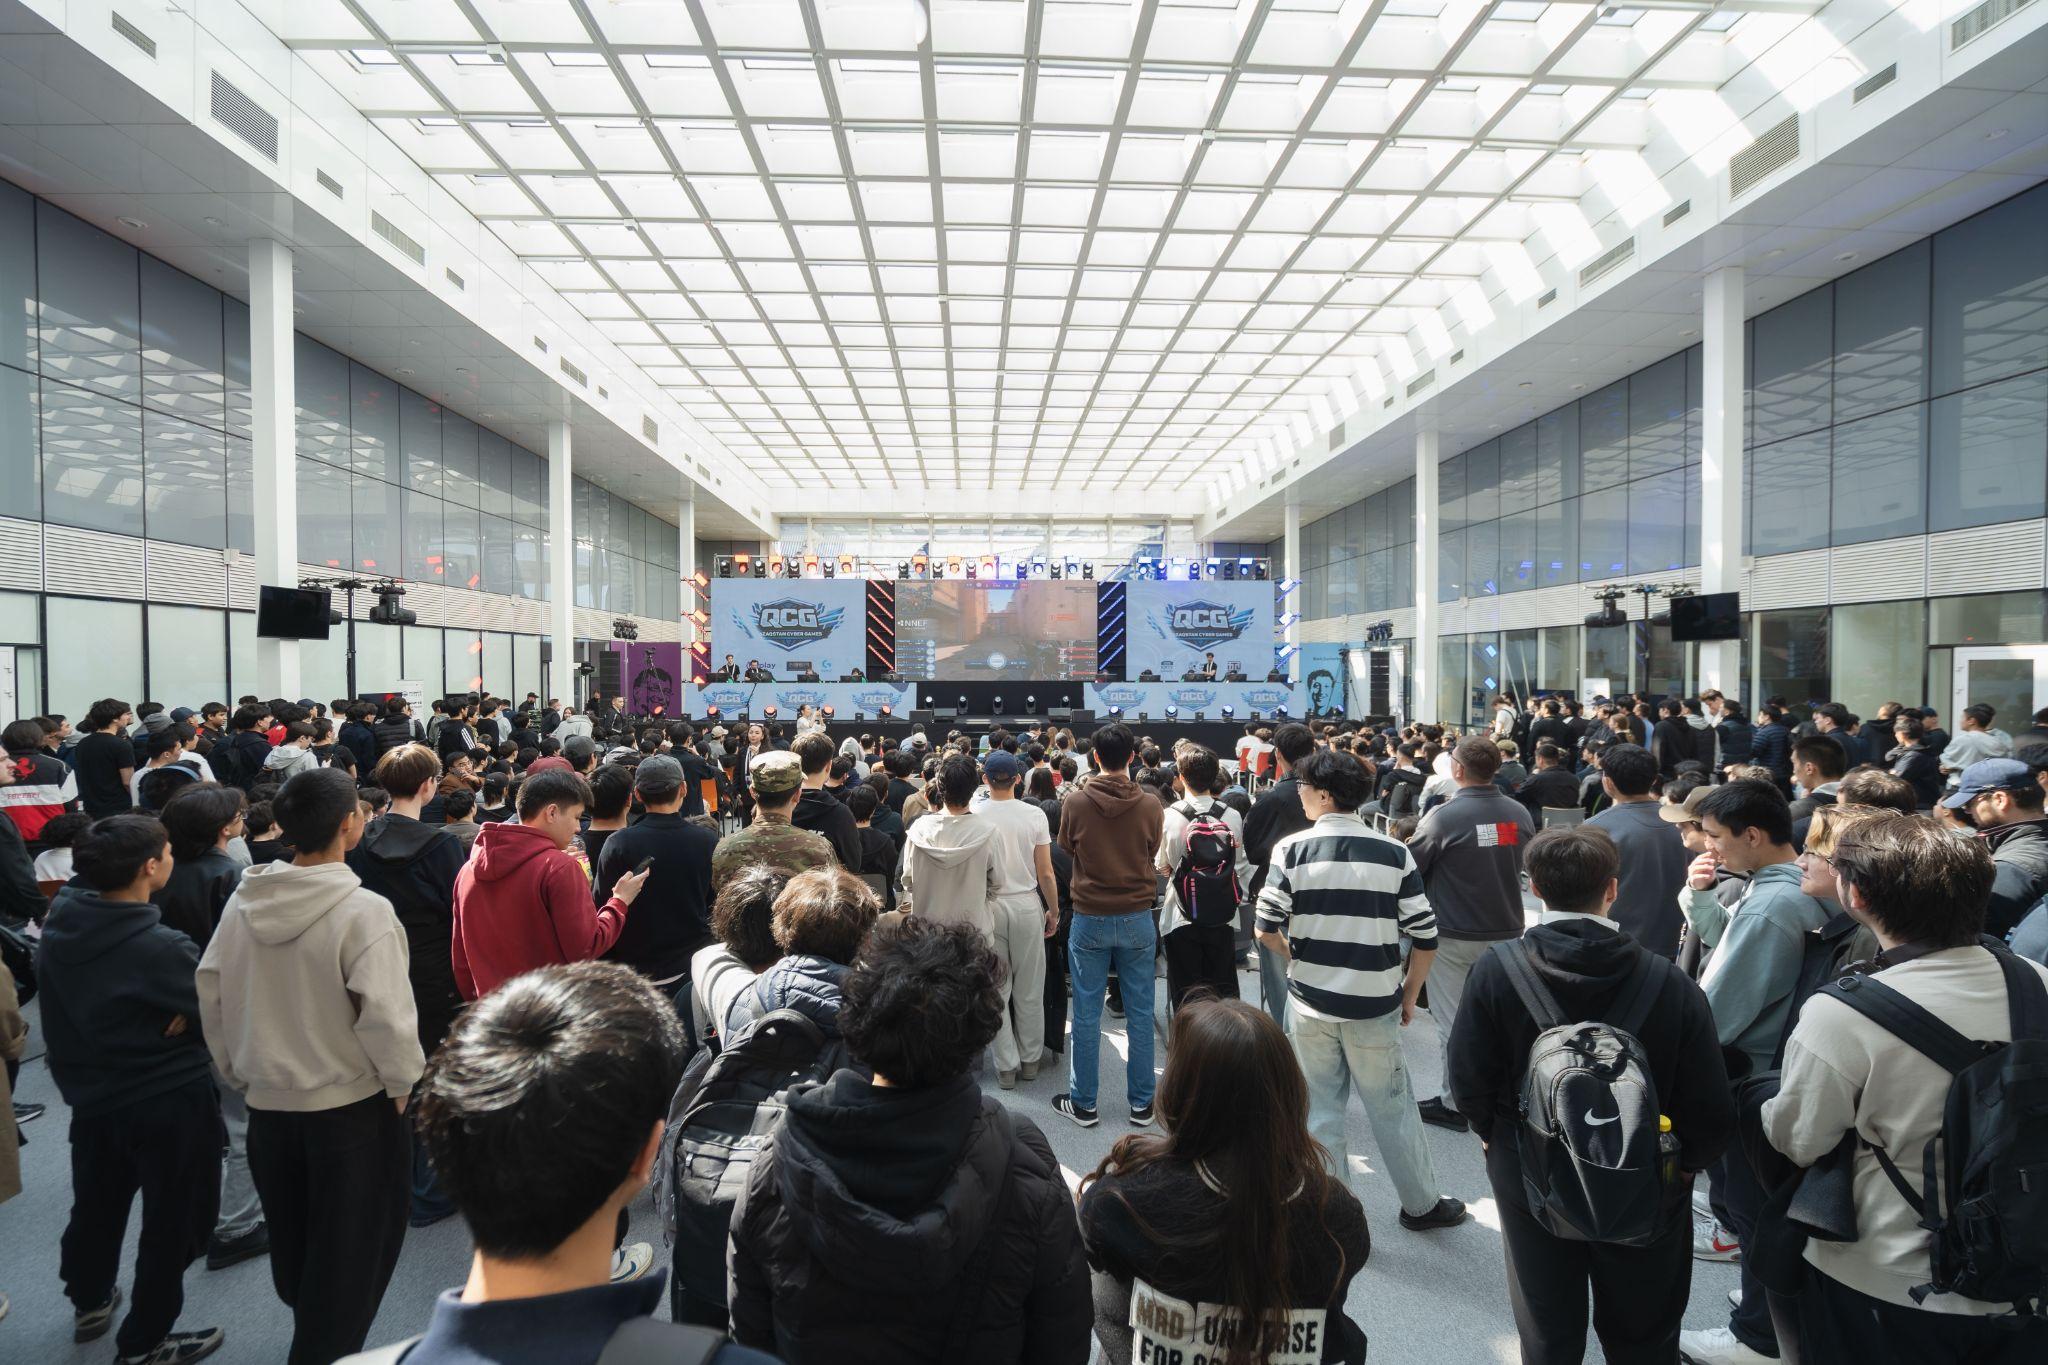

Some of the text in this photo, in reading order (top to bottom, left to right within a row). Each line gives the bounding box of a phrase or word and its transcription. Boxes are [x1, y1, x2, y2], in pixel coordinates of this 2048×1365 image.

[760, 608, 818, 628] QCG
[1173, 610, 1229, 629] QCG
[715, 694, 741, 704] QCG
[788, 694, 814, 704] QCG
[864, 694, 890, 704] QCG
[1110, 692, 1133, 701] QCG
[1181, 692, 1204, 701] QCG
[1254, 693, 1277, 702] QCG
[1203, 1316, 1318, 1353] UNERSE
